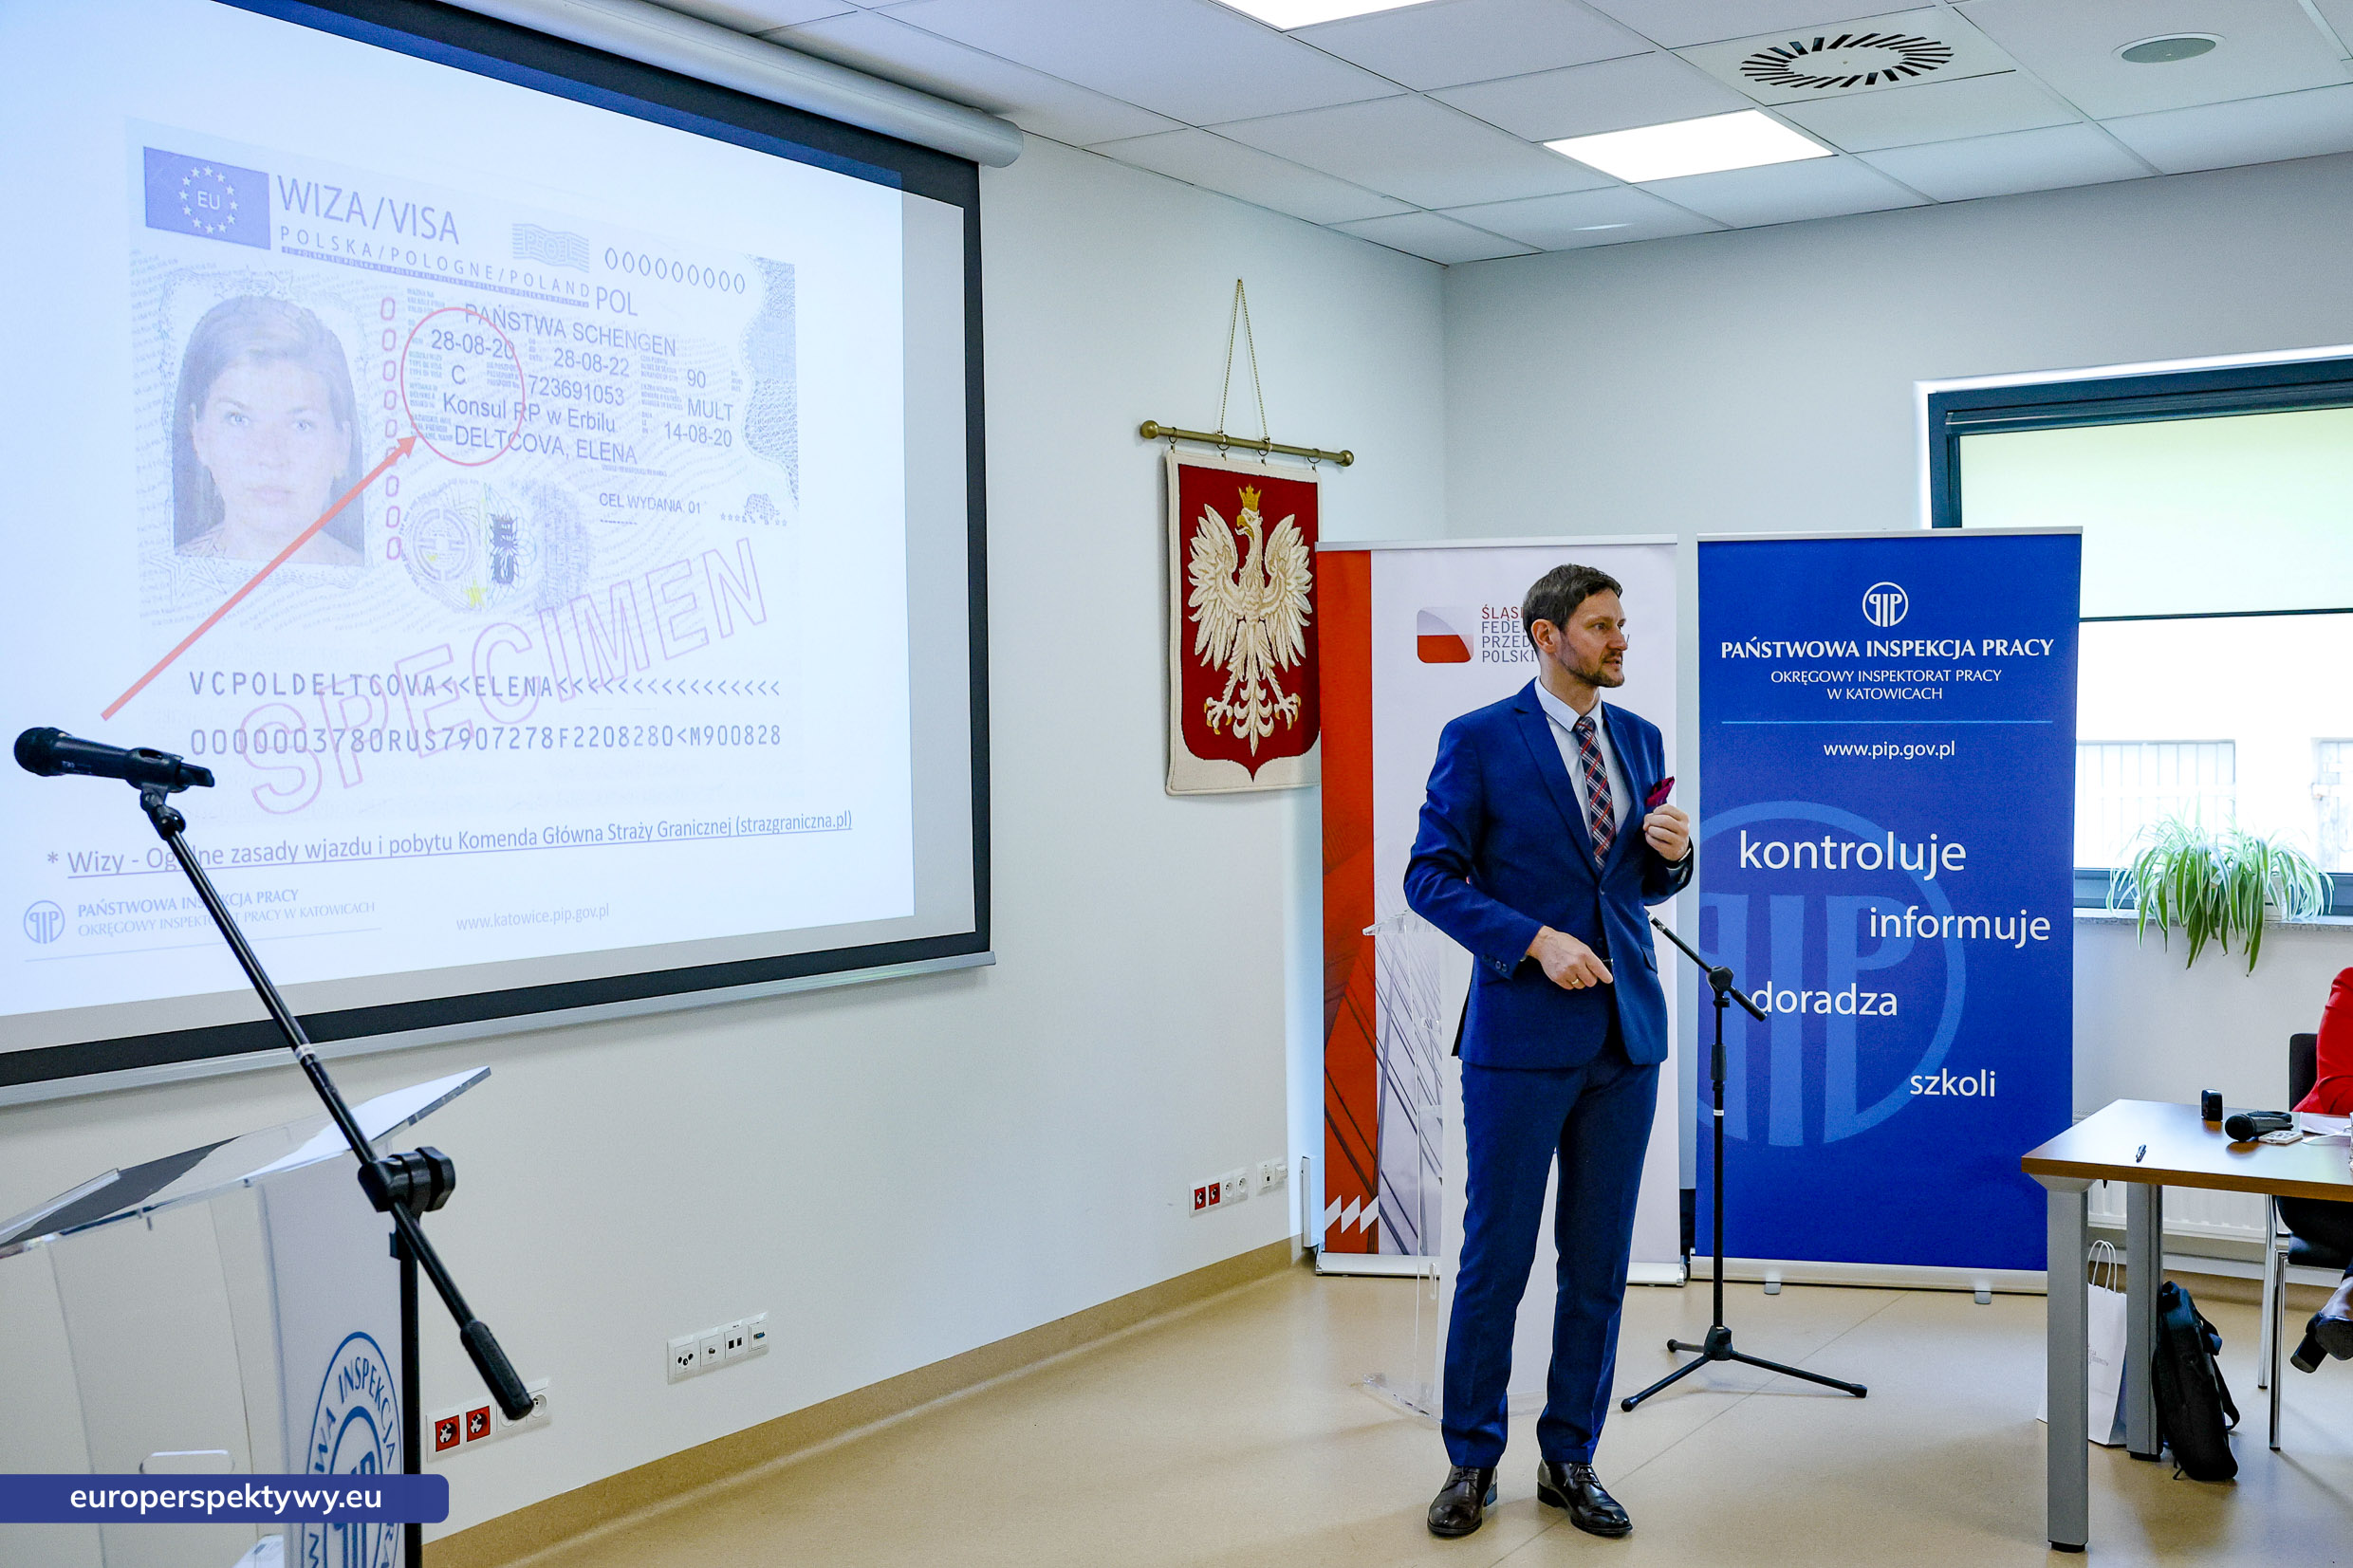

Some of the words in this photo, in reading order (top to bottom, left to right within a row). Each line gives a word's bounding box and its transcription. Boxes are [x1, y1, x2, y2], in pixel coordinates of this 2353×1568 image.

[196, 189, 221, 212] EU
[277, 175, 459, 245] WIZA/VISA
[597, 286, 638, 316] POL
[465, 303, 566, 339] PAŃSTWA
[573, 323, 676, 357] SCHENGEN
[432, 329, 514, 360] 28-08-20
[554, 347, 629, 378] 28-08-22
[452, 364, 466, 385] C
[528, 375, 624, 406] 723691053
[687, 369, 706, 388] 90
[443, 393, 506, 418] Konsul
[514, 402, 541, 422] RP
[547, 410, 562, 425] w
[568, 408, 615, 433] Erbilu
[688, 397, 733, 421] MULT
[664, 421, 732, 448] 14-08-20
[577, 438, 638, 465] ELENA
[600, 492, 624, 507] CEL
[688, 500, 700, 514] 01
[1482, 620, 1525, 634] FEDE
[1482, 636, 1530, 649] PRZED
[1482, 650, 1535, 663] POLSKI
[1721, 636, 1860, 659] PAŃSTWOWA
[1866, 639, 1975, 660] INSPEKCJA
[1982, 638, 2054, 656] PRACY
[240, 537, 767, 814] SPECIMEN
[1770, 670, 1854, 686] OKRĘGOWY
[1858, 669, 1951, 683] INSPEKTORAT
[1955, 669, 2002, 682] PRACY
[1826, 688, 1843, 700] W
[1846, 687, 1942, 700] KATOWICACH
[1824, 740, 1955, 760] www.pip.gov.pl
[68, 850, 124, 875] Wizy
[146, 844, 224, 872] Oglne
[232, 839, 299, 864] zasady
[305, 835, 372, 860] wjazdu
[389, 830, 453, 858] pobytu
[458, 828, 537, 851] Komenda
[543, 824, 604, 846] Główna
[607, 821, 653, 843] Straży
[657, 817, 732, 839] Granicznej
[735, 810, 852, 836] (strazgraniczna.pl)
[1740, 830, 1967, 881] kontroluje
[78, 897, 177, 918] PAŃSTWOWA
[181, 892, 251, 912] INSKCJA
[257, 889, 299, 904] PRACY
[455, 903, 609, 932] www.katowice.pip.gov.pl
[78, 919, 157, 938] OKRĘGOWY
[244, 908, 282, 924] PRACY
[284, 907, 296, 920] W
[299, 901, 375, 919] KATOWICACH
[1869, 905, 2051, 949] informuje
[1751, 980, 1899, 1016] doradza
[1909, 1068, 1995, 1098] szkoli
[338, 1356, 396, 1469] INSPEKCJA
